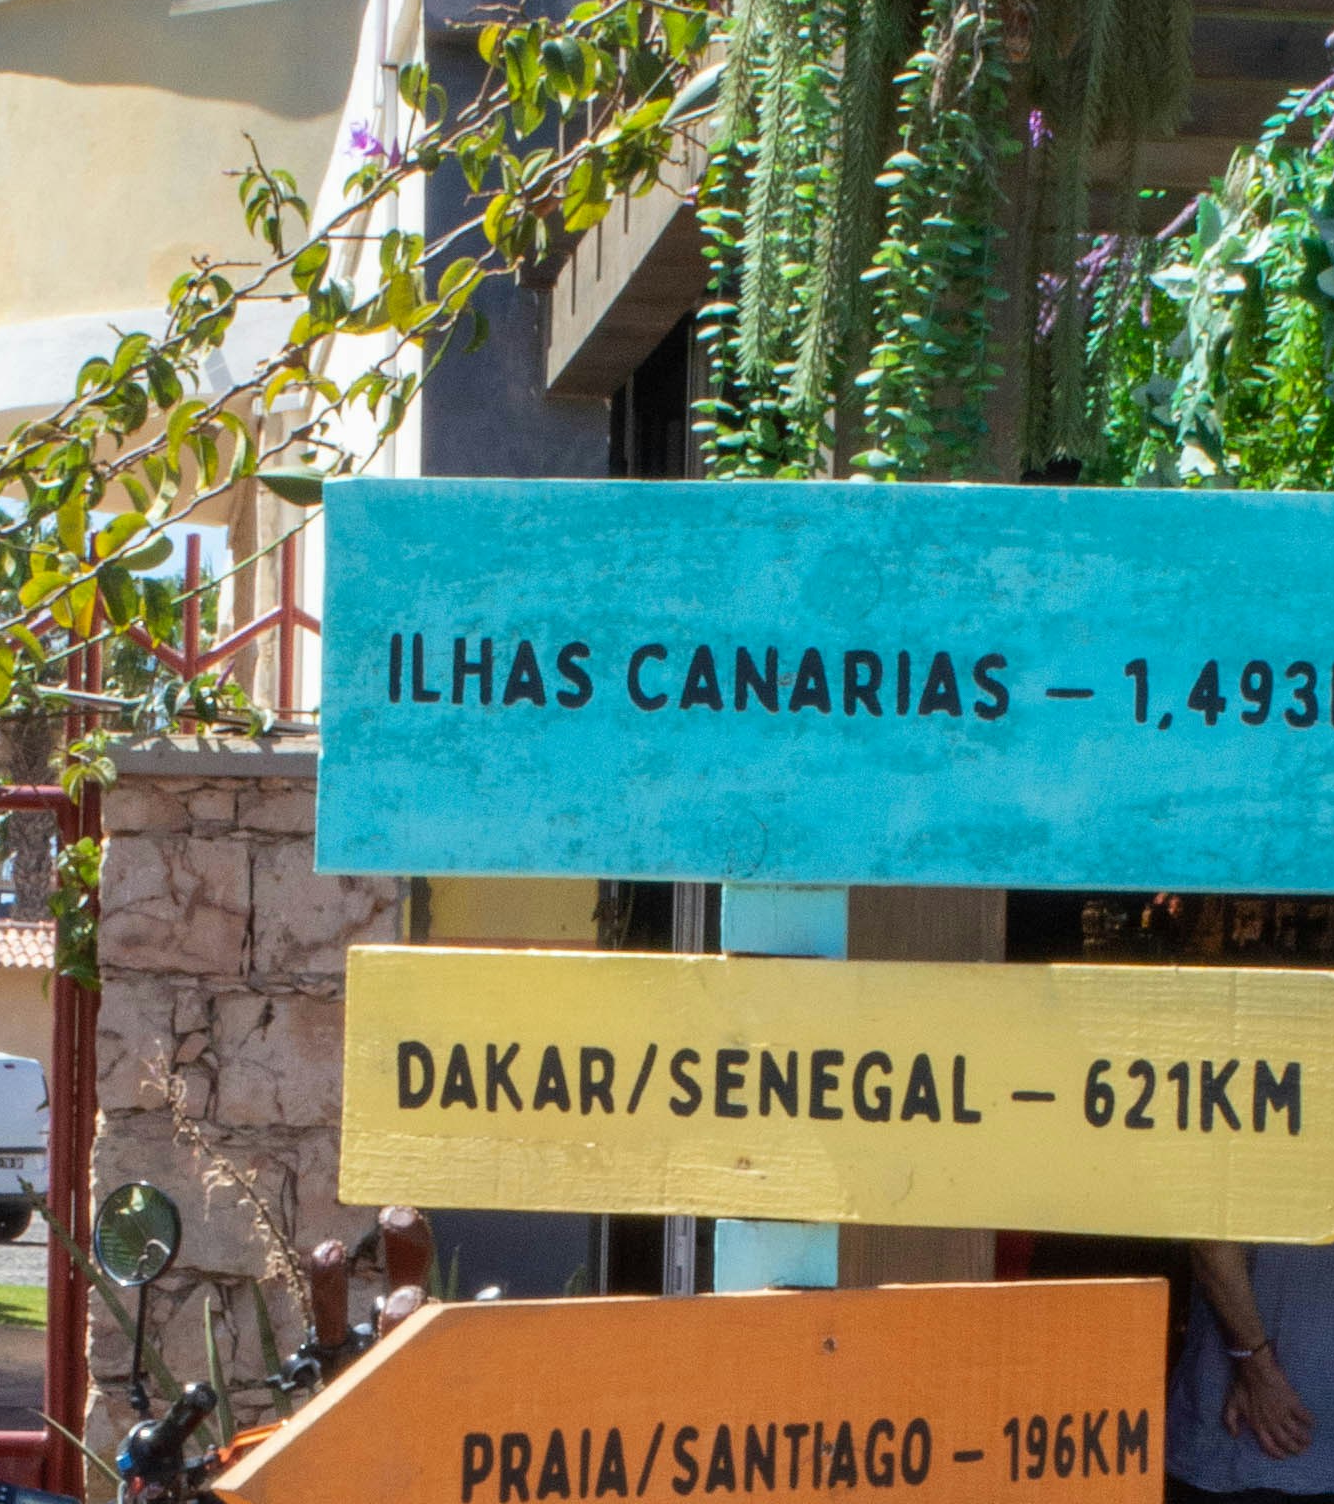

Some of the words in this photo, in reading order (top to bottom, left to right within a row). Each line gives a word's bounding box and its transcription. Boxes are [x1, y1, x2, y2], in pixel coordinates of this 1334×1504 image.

[387, 631, 595, 710] ILHAS
[625, 641, 1012, 722] CANARIAS
[396, 1039, 983, 1125] DAKAR/SENEGAL
[1083, 1058, 1302, 1137] 621KM
[460, 1416, 934, 1504] PRAIA/SANTIAGO
[1002, 1407, 1150, 1483] 196KM
